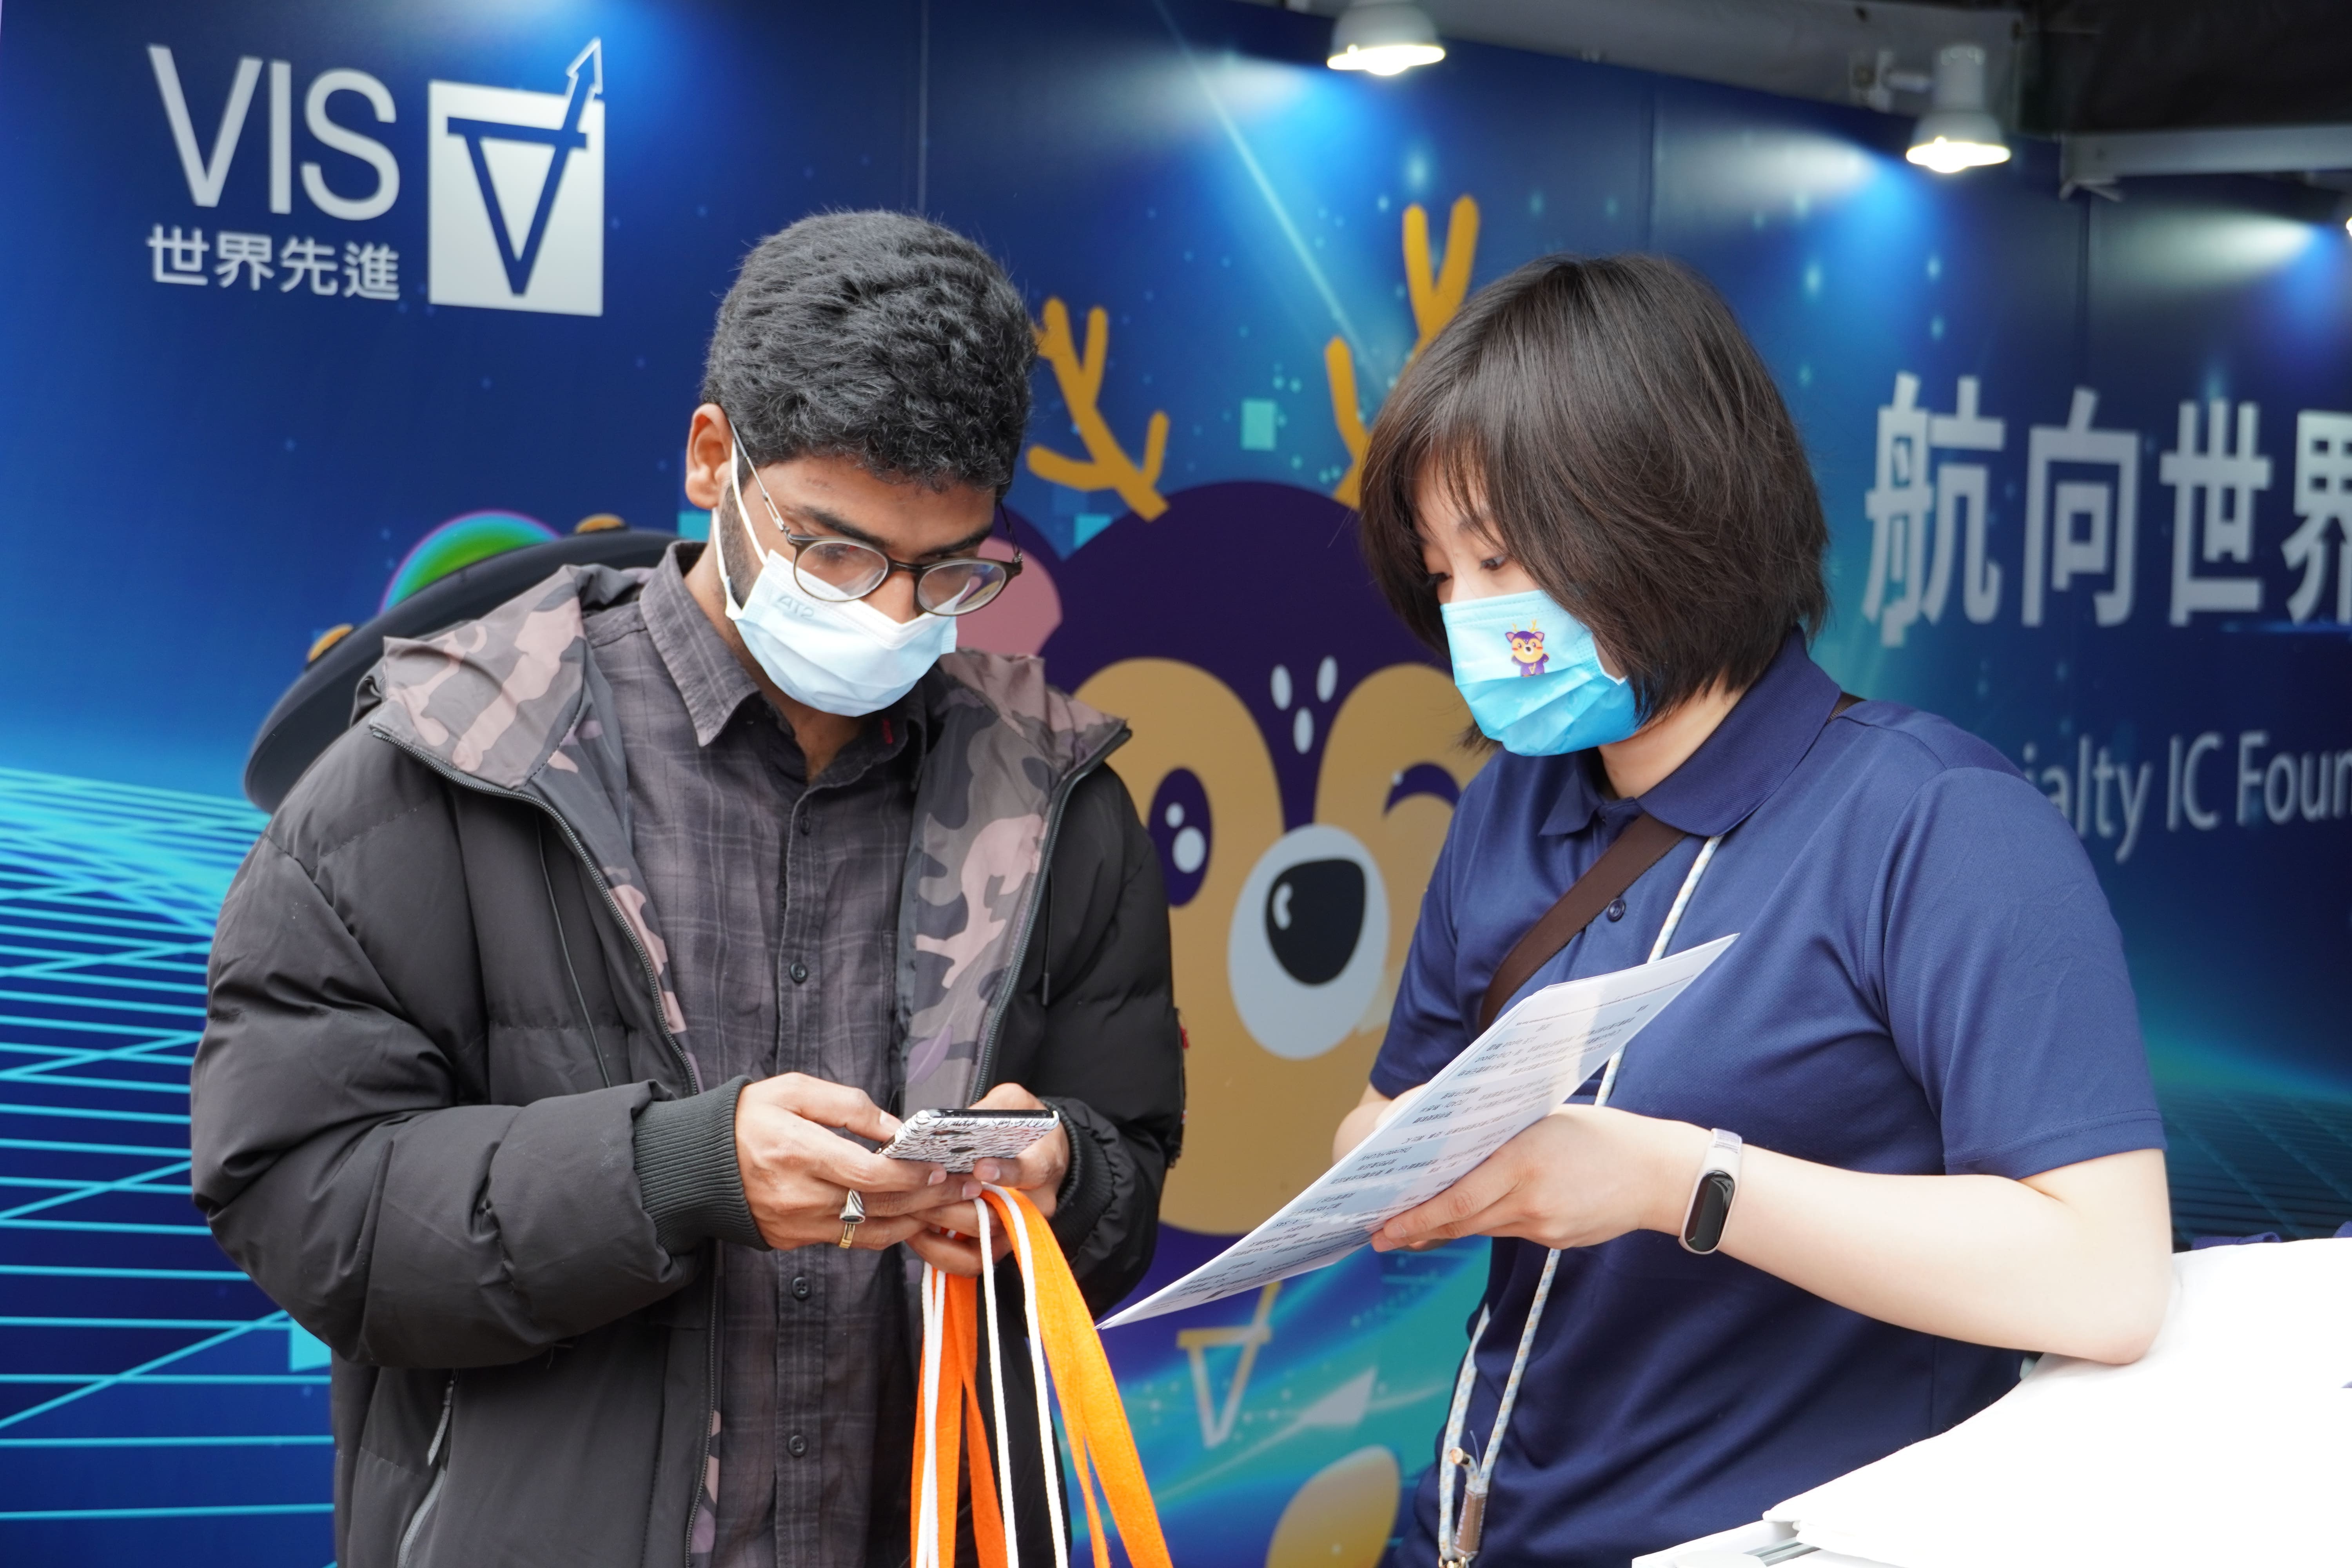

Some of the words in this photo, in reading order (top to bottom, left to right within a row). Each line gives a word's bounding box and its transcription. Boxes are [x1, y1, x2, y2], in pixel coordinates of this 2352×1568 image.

[147, 44, 401, 221] VIS
[147, 223, 400, 301] 世界先進
[1861, 370, 2352, 649] 航向世界
[2166, 731, 2223, 832] IC
